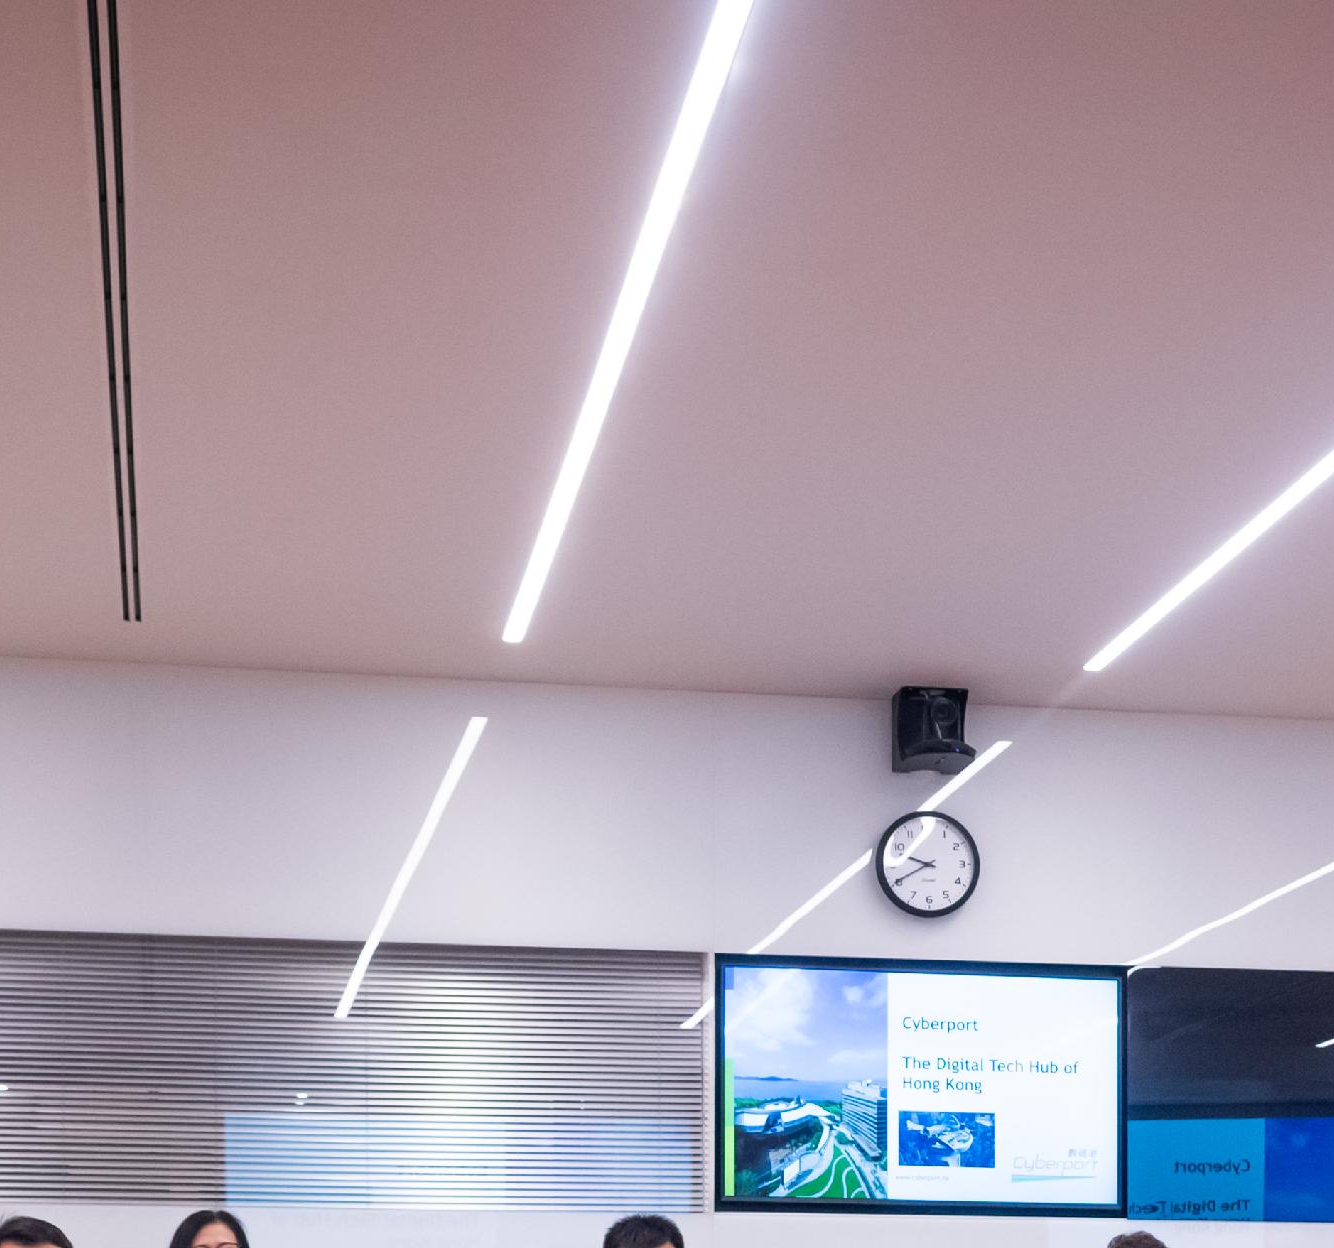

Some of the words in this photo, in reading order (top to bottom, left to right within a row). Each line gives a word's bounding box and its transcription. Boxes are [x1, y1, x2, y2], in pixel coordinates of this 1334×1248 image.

[902, 1016, 978, 1033] Cyberport
[902, 1056, 931, 1069] The
[937, 1057, 984, 1073] Digital
[989, 1059, 1023, 1073] Tech
[1029, 1060, 1058, 1074] Hub
[1064, 1061, 1079, 1074] of
[903, 1077, 940, 1093] Hong
[945, 1078, 982, 1094] Kong
